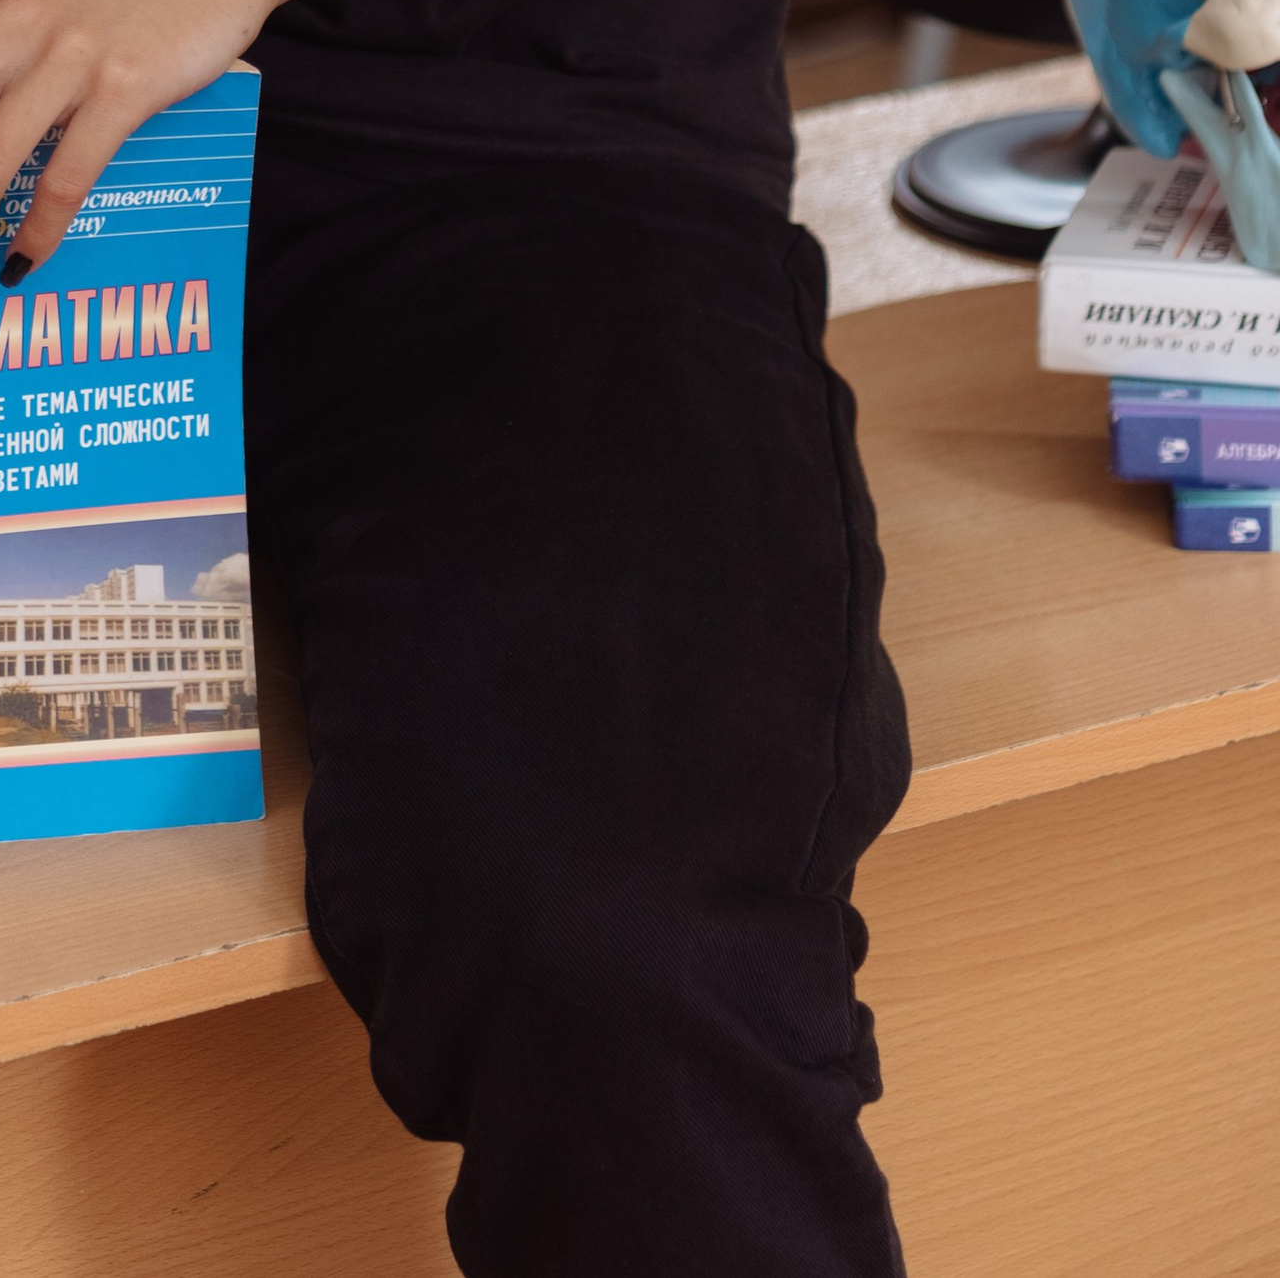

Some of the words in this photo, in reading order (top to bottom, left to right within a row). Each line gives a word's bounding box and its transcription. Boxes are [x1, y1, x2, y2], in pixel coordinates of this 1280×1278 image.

[1084, 302, 1222, 331] СКАНАВИ
[22, 379, 195, 418] ТЕМАТИЧЕСКИЕ
[79, 413, 210, 448] СЛОЖНОСТИ
